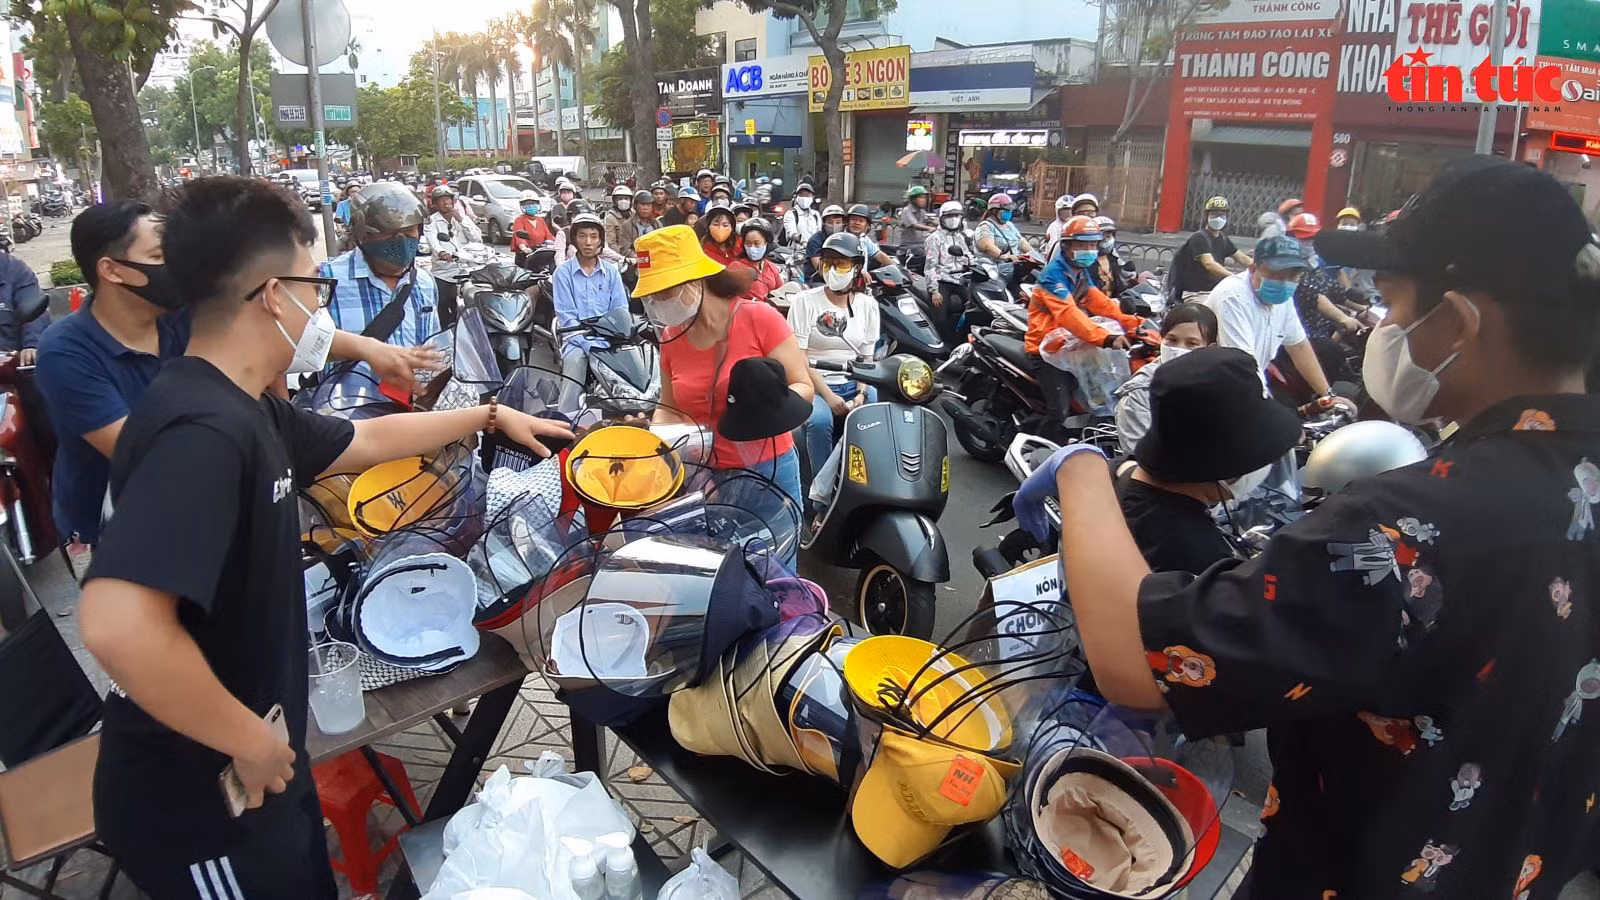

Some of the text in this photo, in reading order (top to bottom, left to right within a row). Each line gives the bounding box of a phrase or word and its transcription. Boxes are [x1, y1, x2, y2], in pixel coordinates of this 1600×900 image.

[853, 61, 862, 85] 3
[866, 57, 905, 83] NGON
[1261, 46, 1330, 78] CÔNG
[1337, 43, 1393, 93] KHOA
[678, 79, 713, 93] DOANH
[725, 65, 763, 94] ACB
[1035, 576, 1057, 596] NÓN
